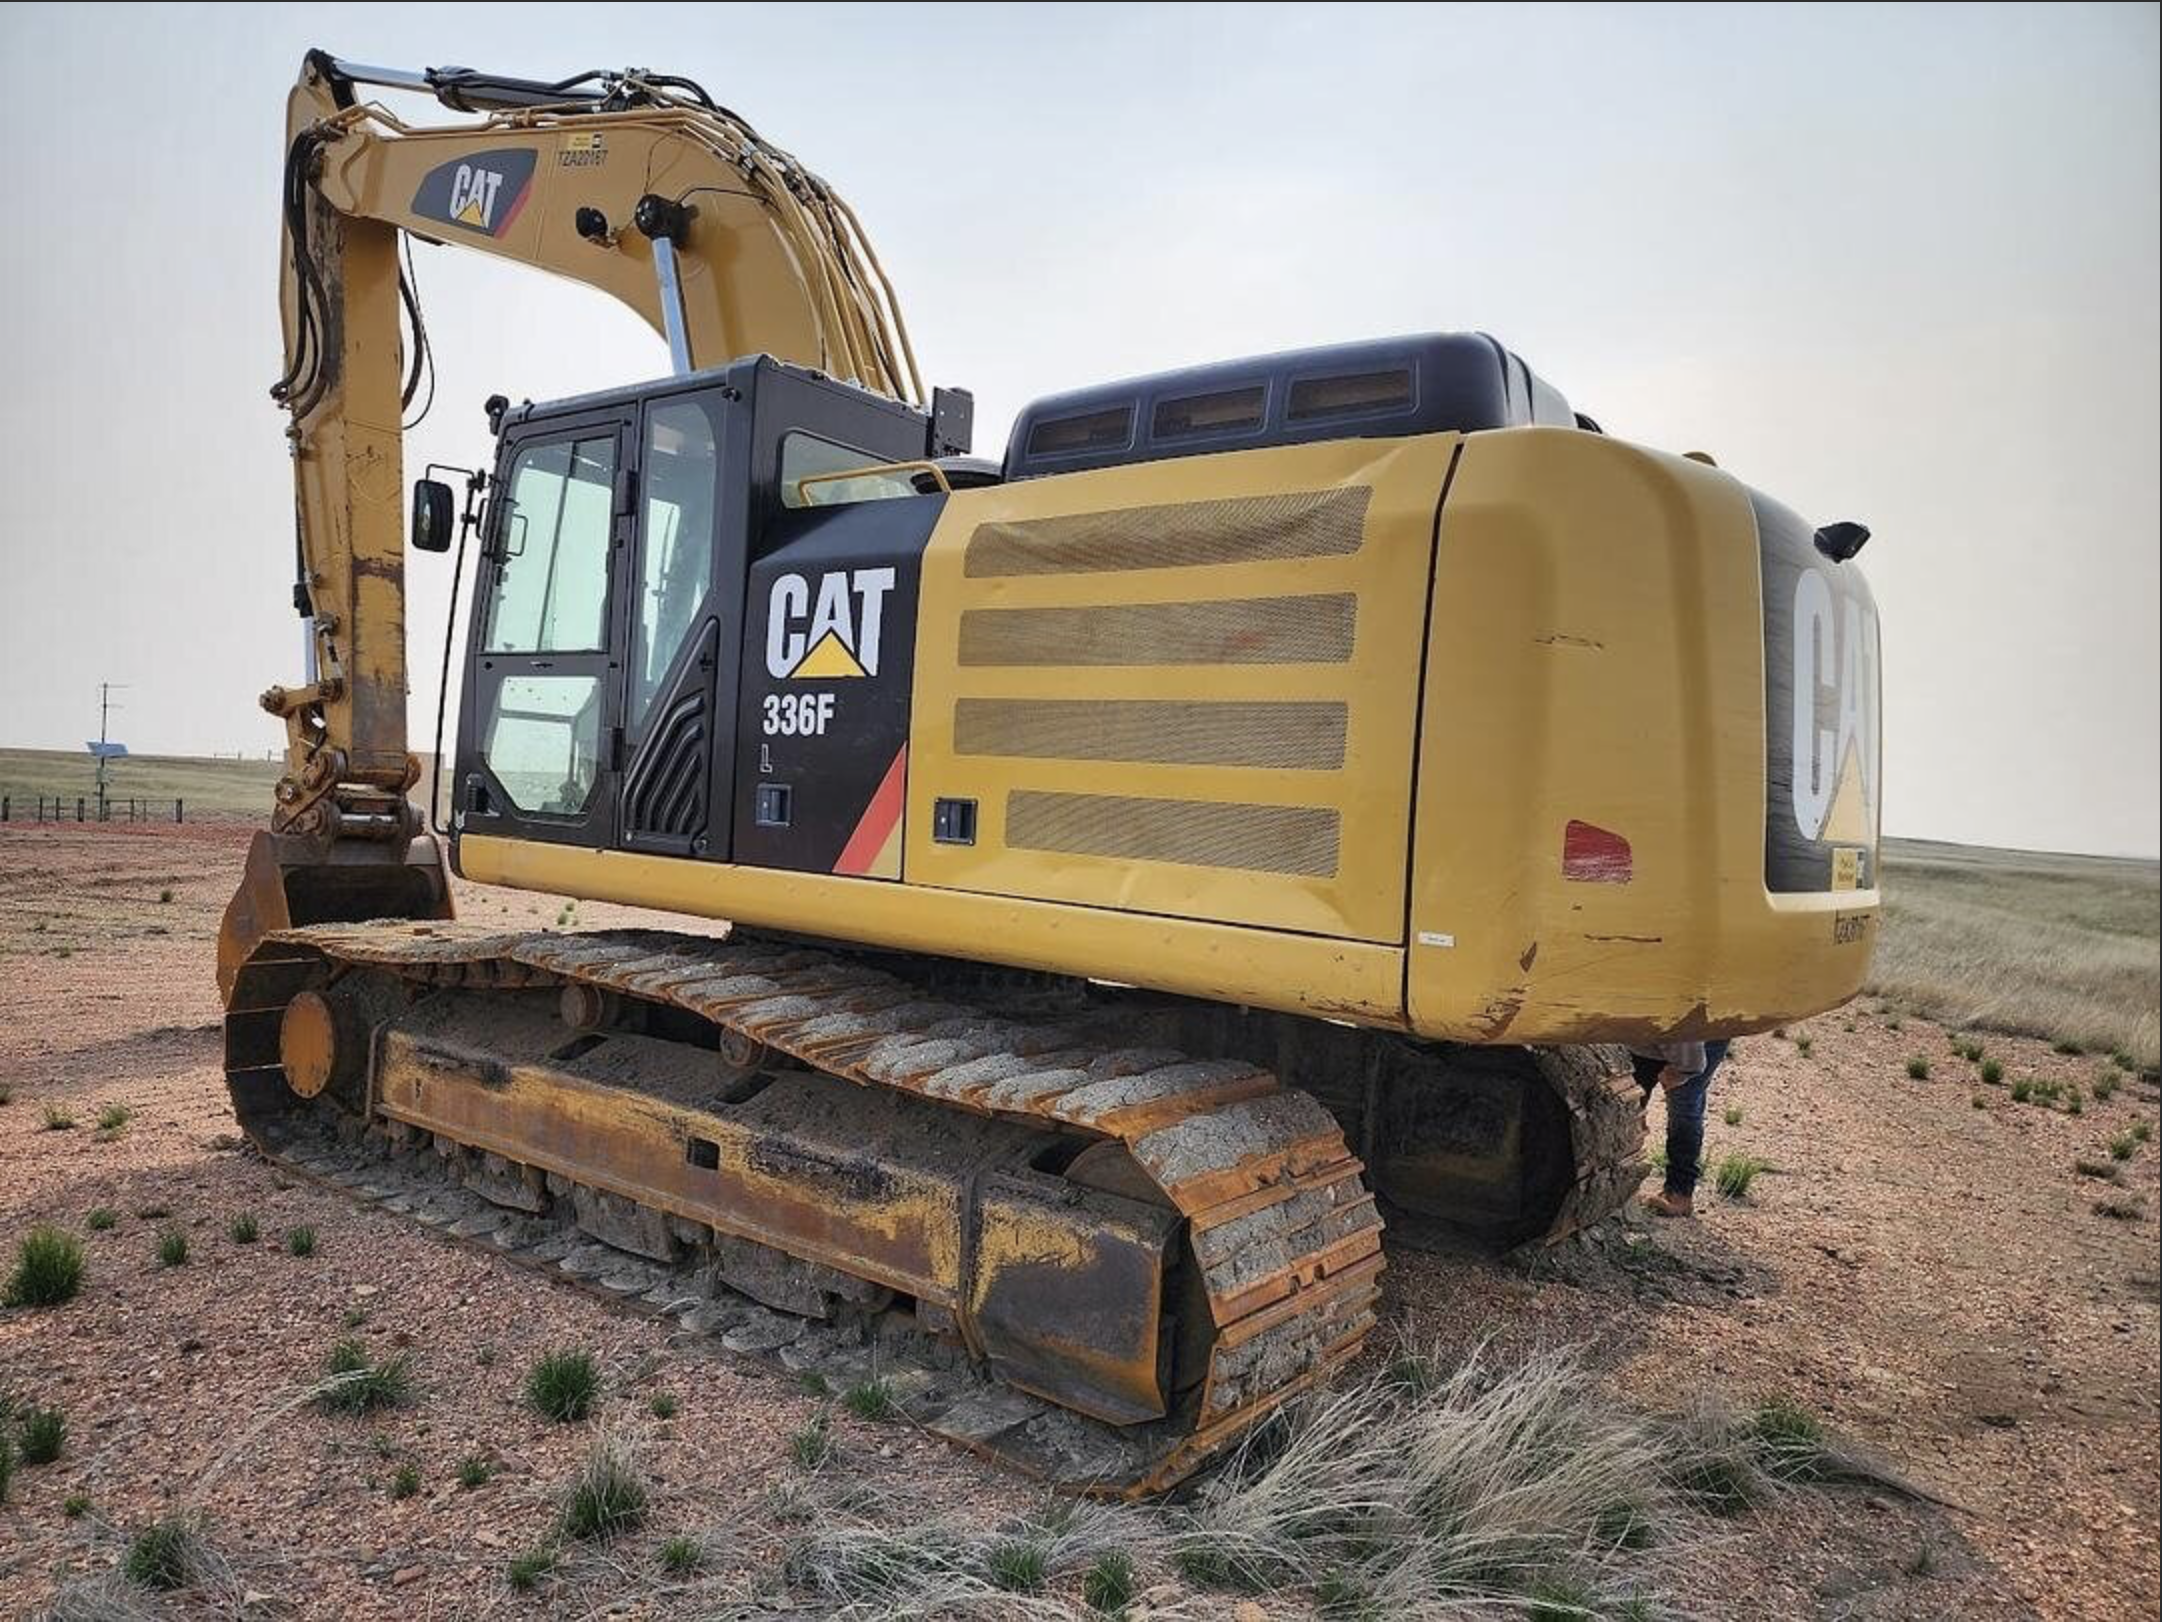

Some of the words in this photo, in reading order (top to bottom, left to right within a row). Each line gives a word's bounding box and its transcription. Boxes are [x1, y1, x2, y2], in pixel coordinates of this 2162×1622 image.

[450, 163, 503, 228] CAT
[766, 567, 896, 679] CAT
[763, 694, 835, 735] 336F
[760, 744, 773, 773] L
